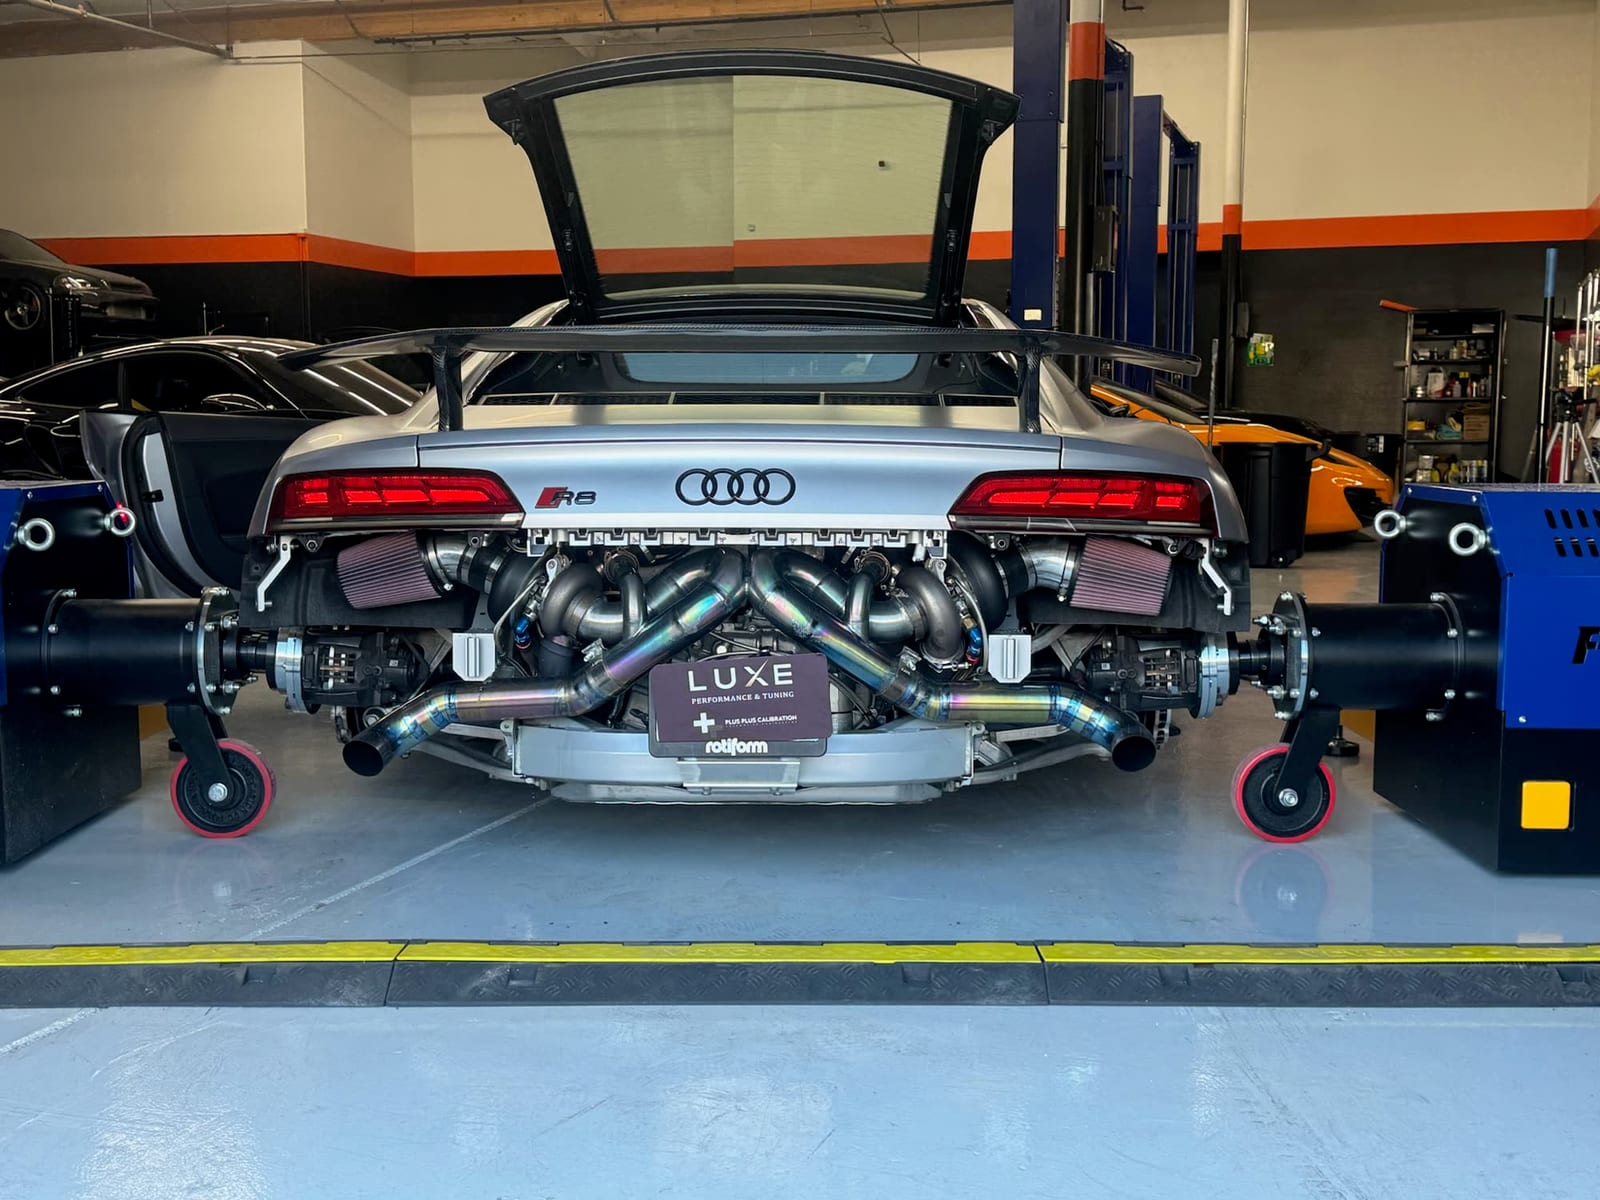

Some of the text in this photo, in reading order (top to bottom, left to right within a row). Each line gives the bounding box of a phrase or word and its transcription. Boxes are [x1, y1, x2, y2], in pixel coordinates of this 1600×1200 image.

[550, 490, 597, 506] R8
[688, 659, 793, 691] LUXE
[691, 694, 753, 704] PERFORMANCE
[762, 691, 795, 699] TUNING
[757, 715, 797, 723] CALIBRATION
[705, 738, 768, 756] rotiform
